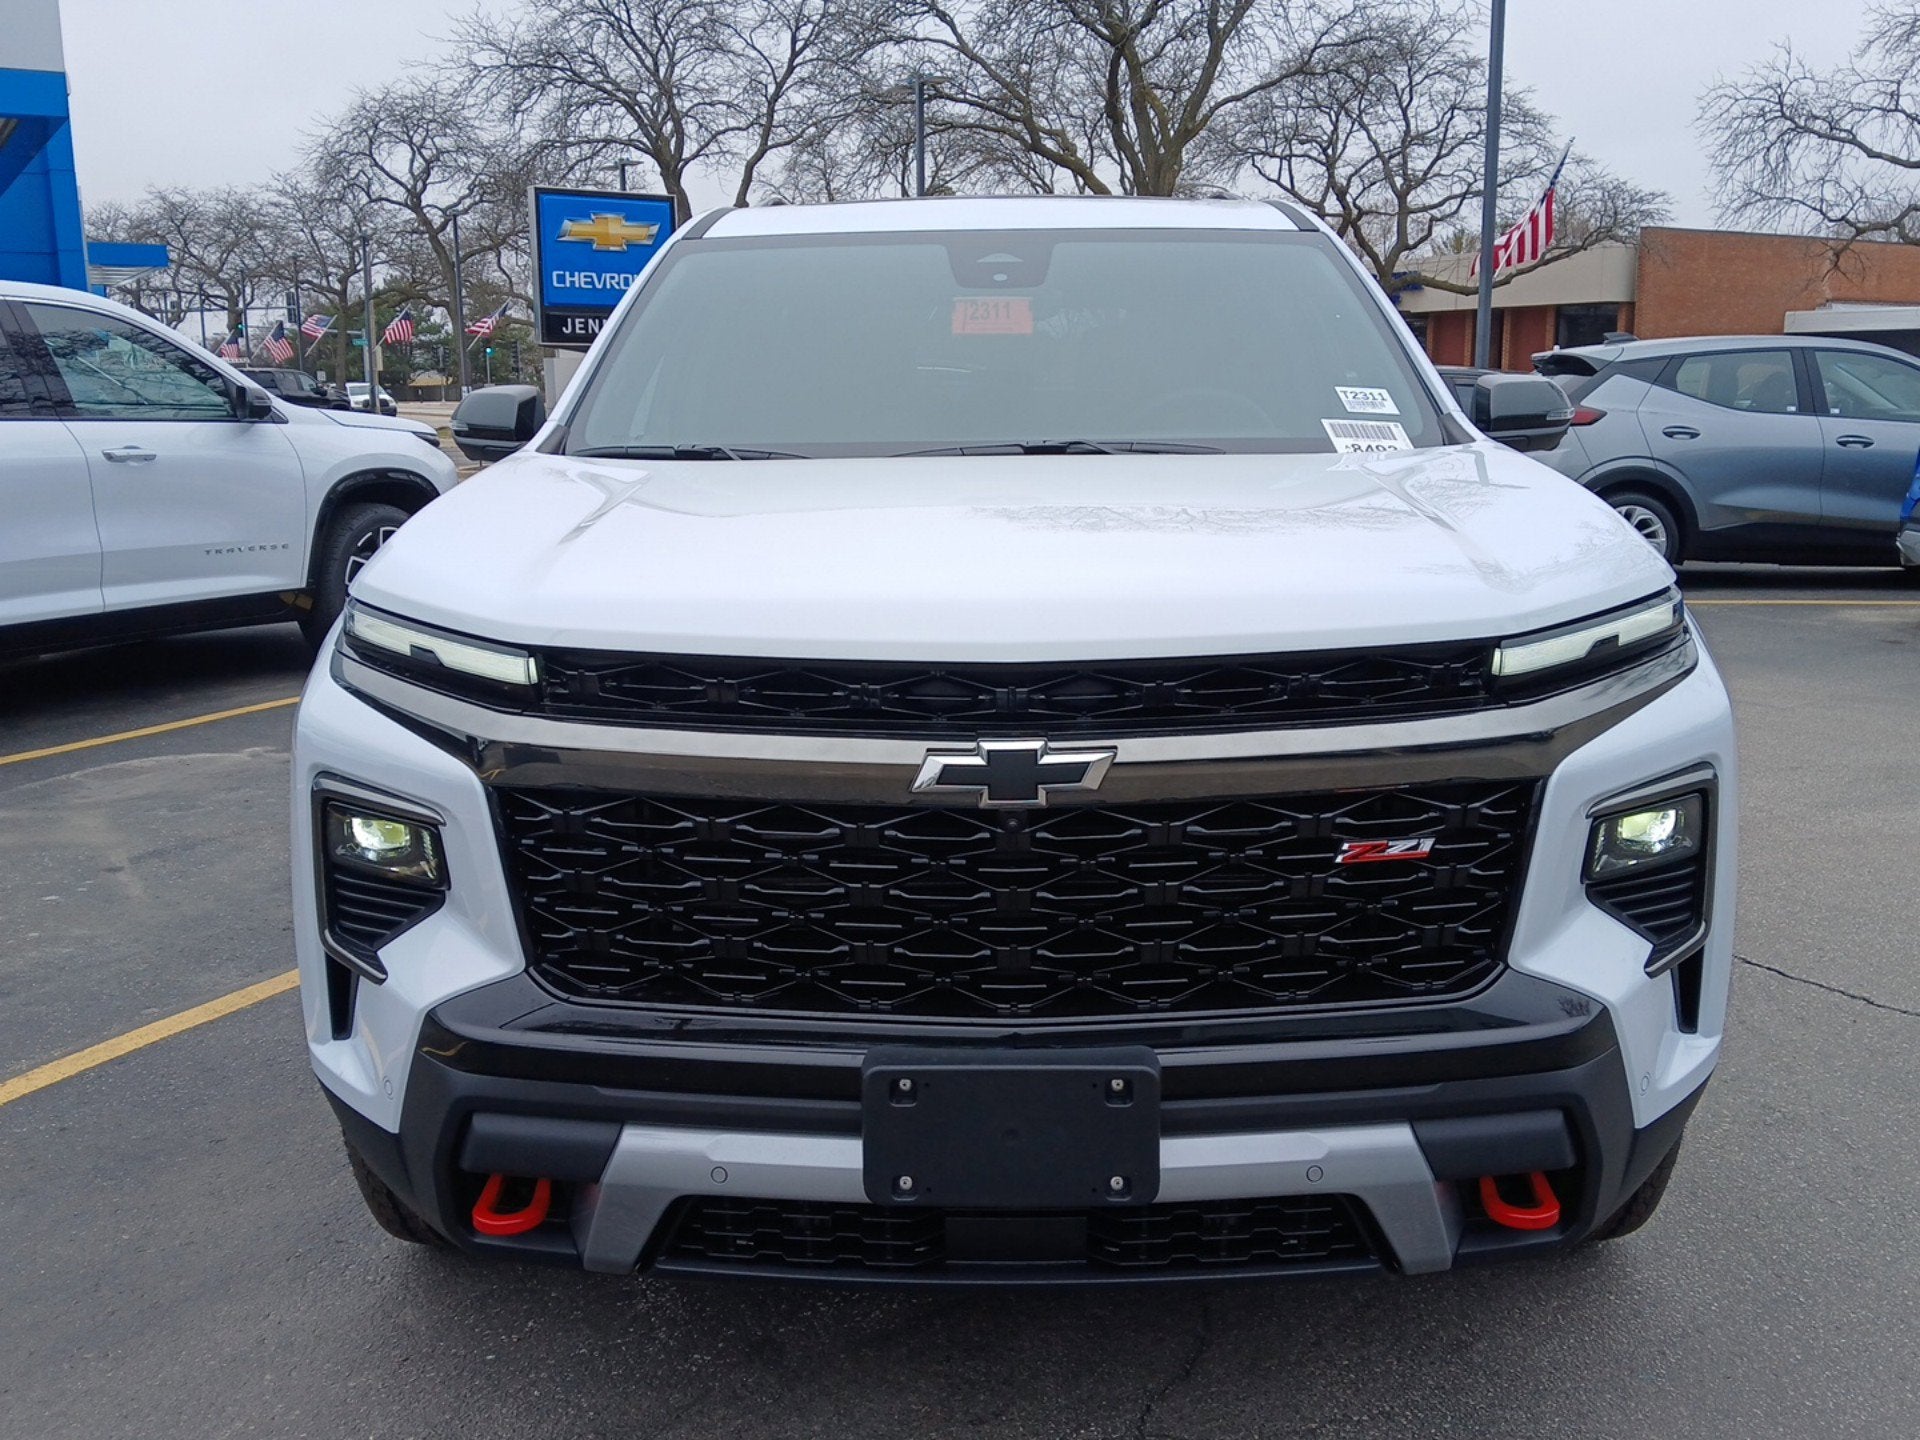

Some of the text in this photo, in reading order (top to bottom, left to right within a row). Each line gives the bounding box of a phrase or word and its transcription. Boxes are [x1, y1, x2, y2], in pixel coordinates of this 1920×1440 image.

[552, 270, 637, 290] CHEVRO
[562, 317, 607, 334] JEN
[1340, 390, 1387, 401] T2311
[205, 544, 289, 556] TRAVERSE
[1335, 838, 1436, 863] Z71
